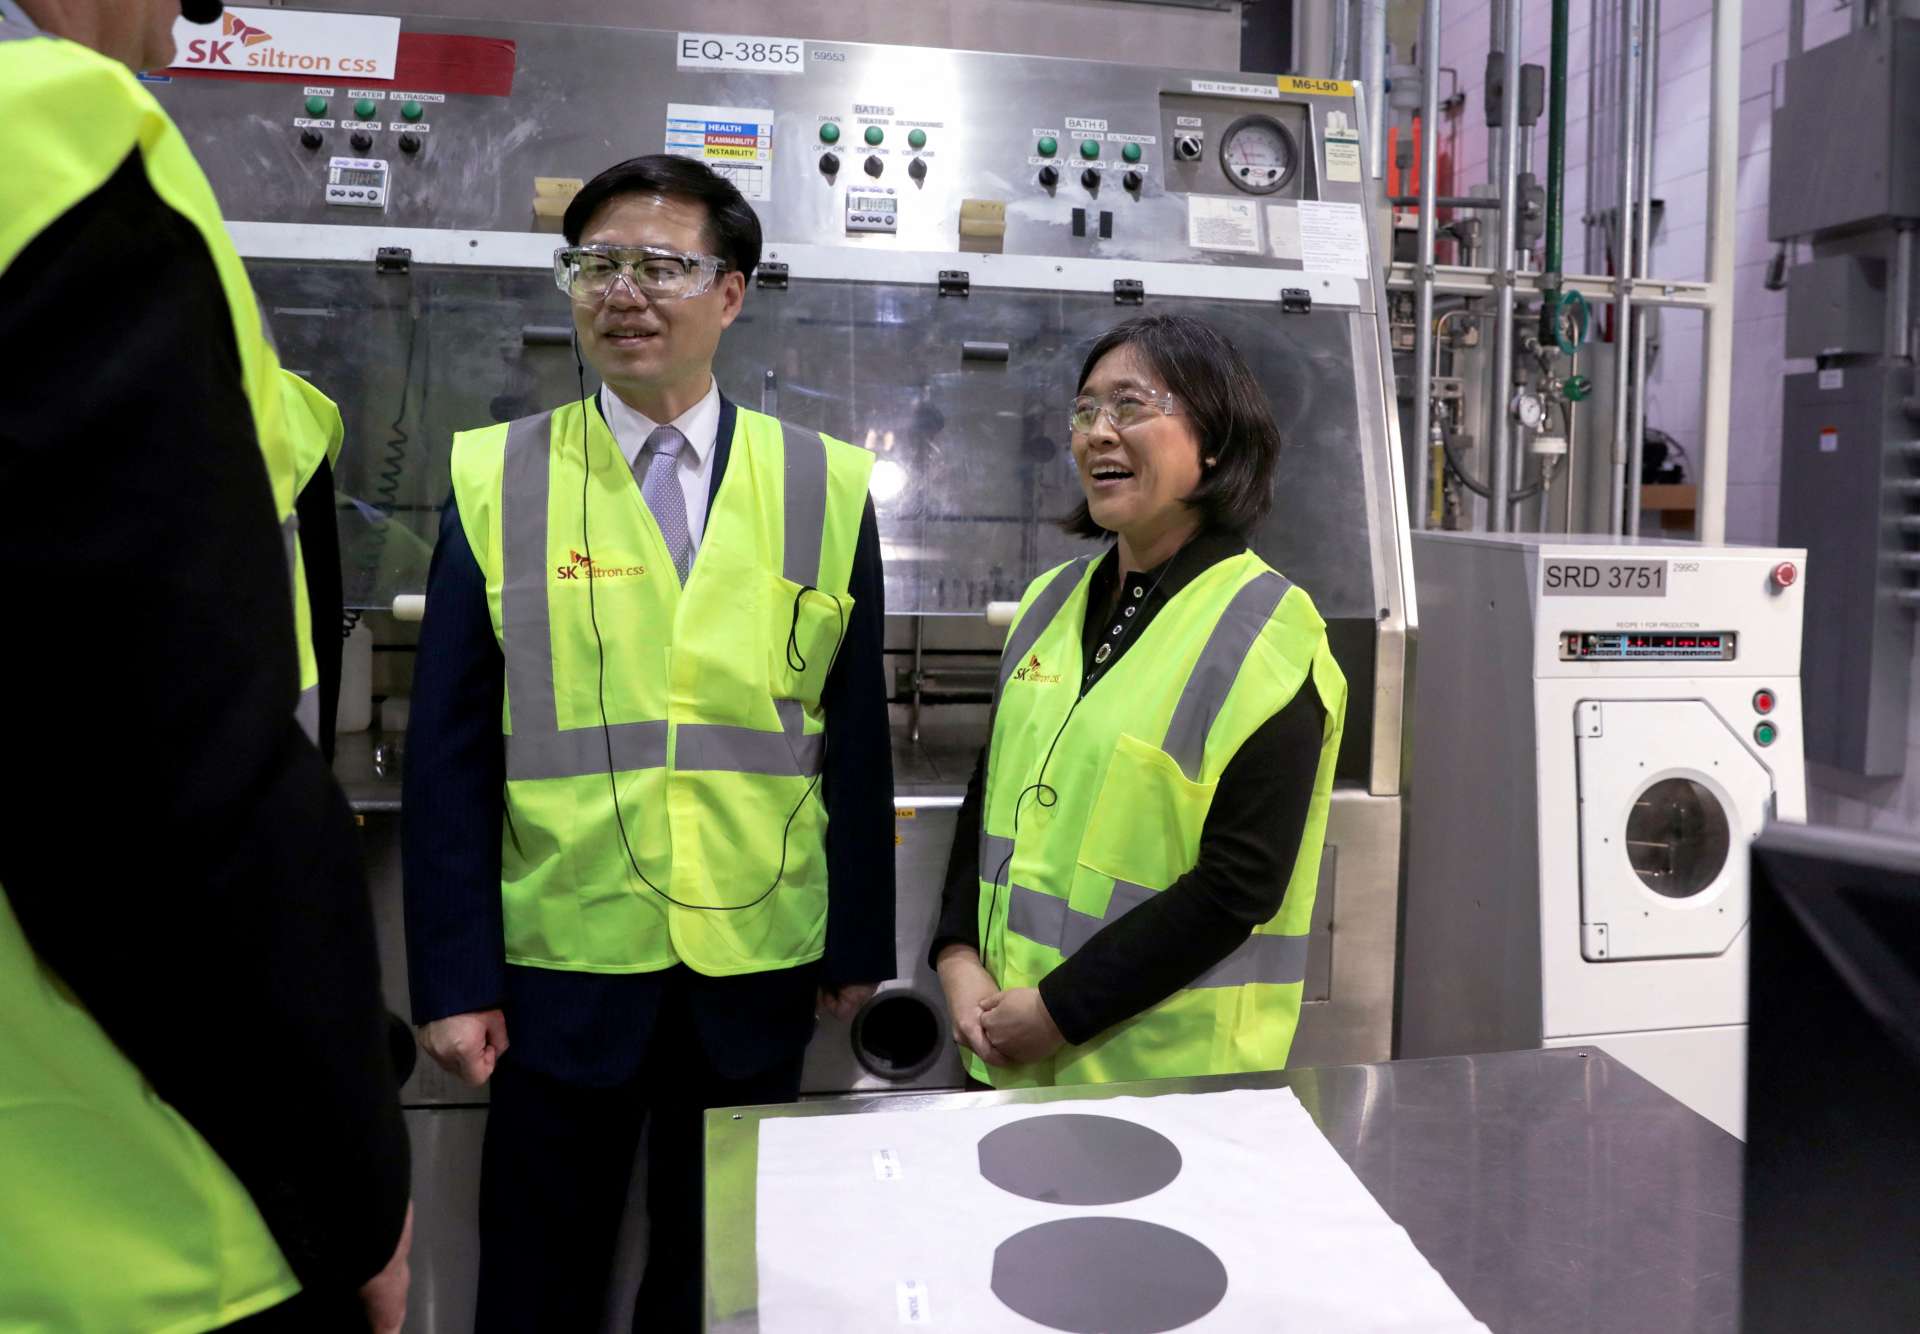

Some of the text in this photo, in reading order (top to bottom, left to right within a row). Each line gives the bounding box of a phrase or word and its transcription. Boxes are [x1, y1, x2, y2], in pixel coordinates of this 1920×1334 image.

[186, 39, 377, 73] SK siltron css
[682, 39, 800, 64] EQ-3855
[1292, 79, 1339, 92] M6-L90
[351, 91, 383, 99] HEATER
[392, 93, 443, 102] ULTRASONIC
[854, 104, 883, 115] BATH
[319, 120, 332, 128] ON
[366, 122, 379, 130] ON
[415, 124, 427, 132] ON
[707, 124, 742, 133] HEALTH
[1068, 119, 1096, 129] BATH
[707, 136, 754, 145] FLAMMABILITY
[707, 148, 754, 157] INSTABILITY
[557, 565, 578, 579] SK
[626, 566, 645, 576] css
[1546, 565, 1663, 588] SRD 3751
[1013, 667, 1030, 681] SK
